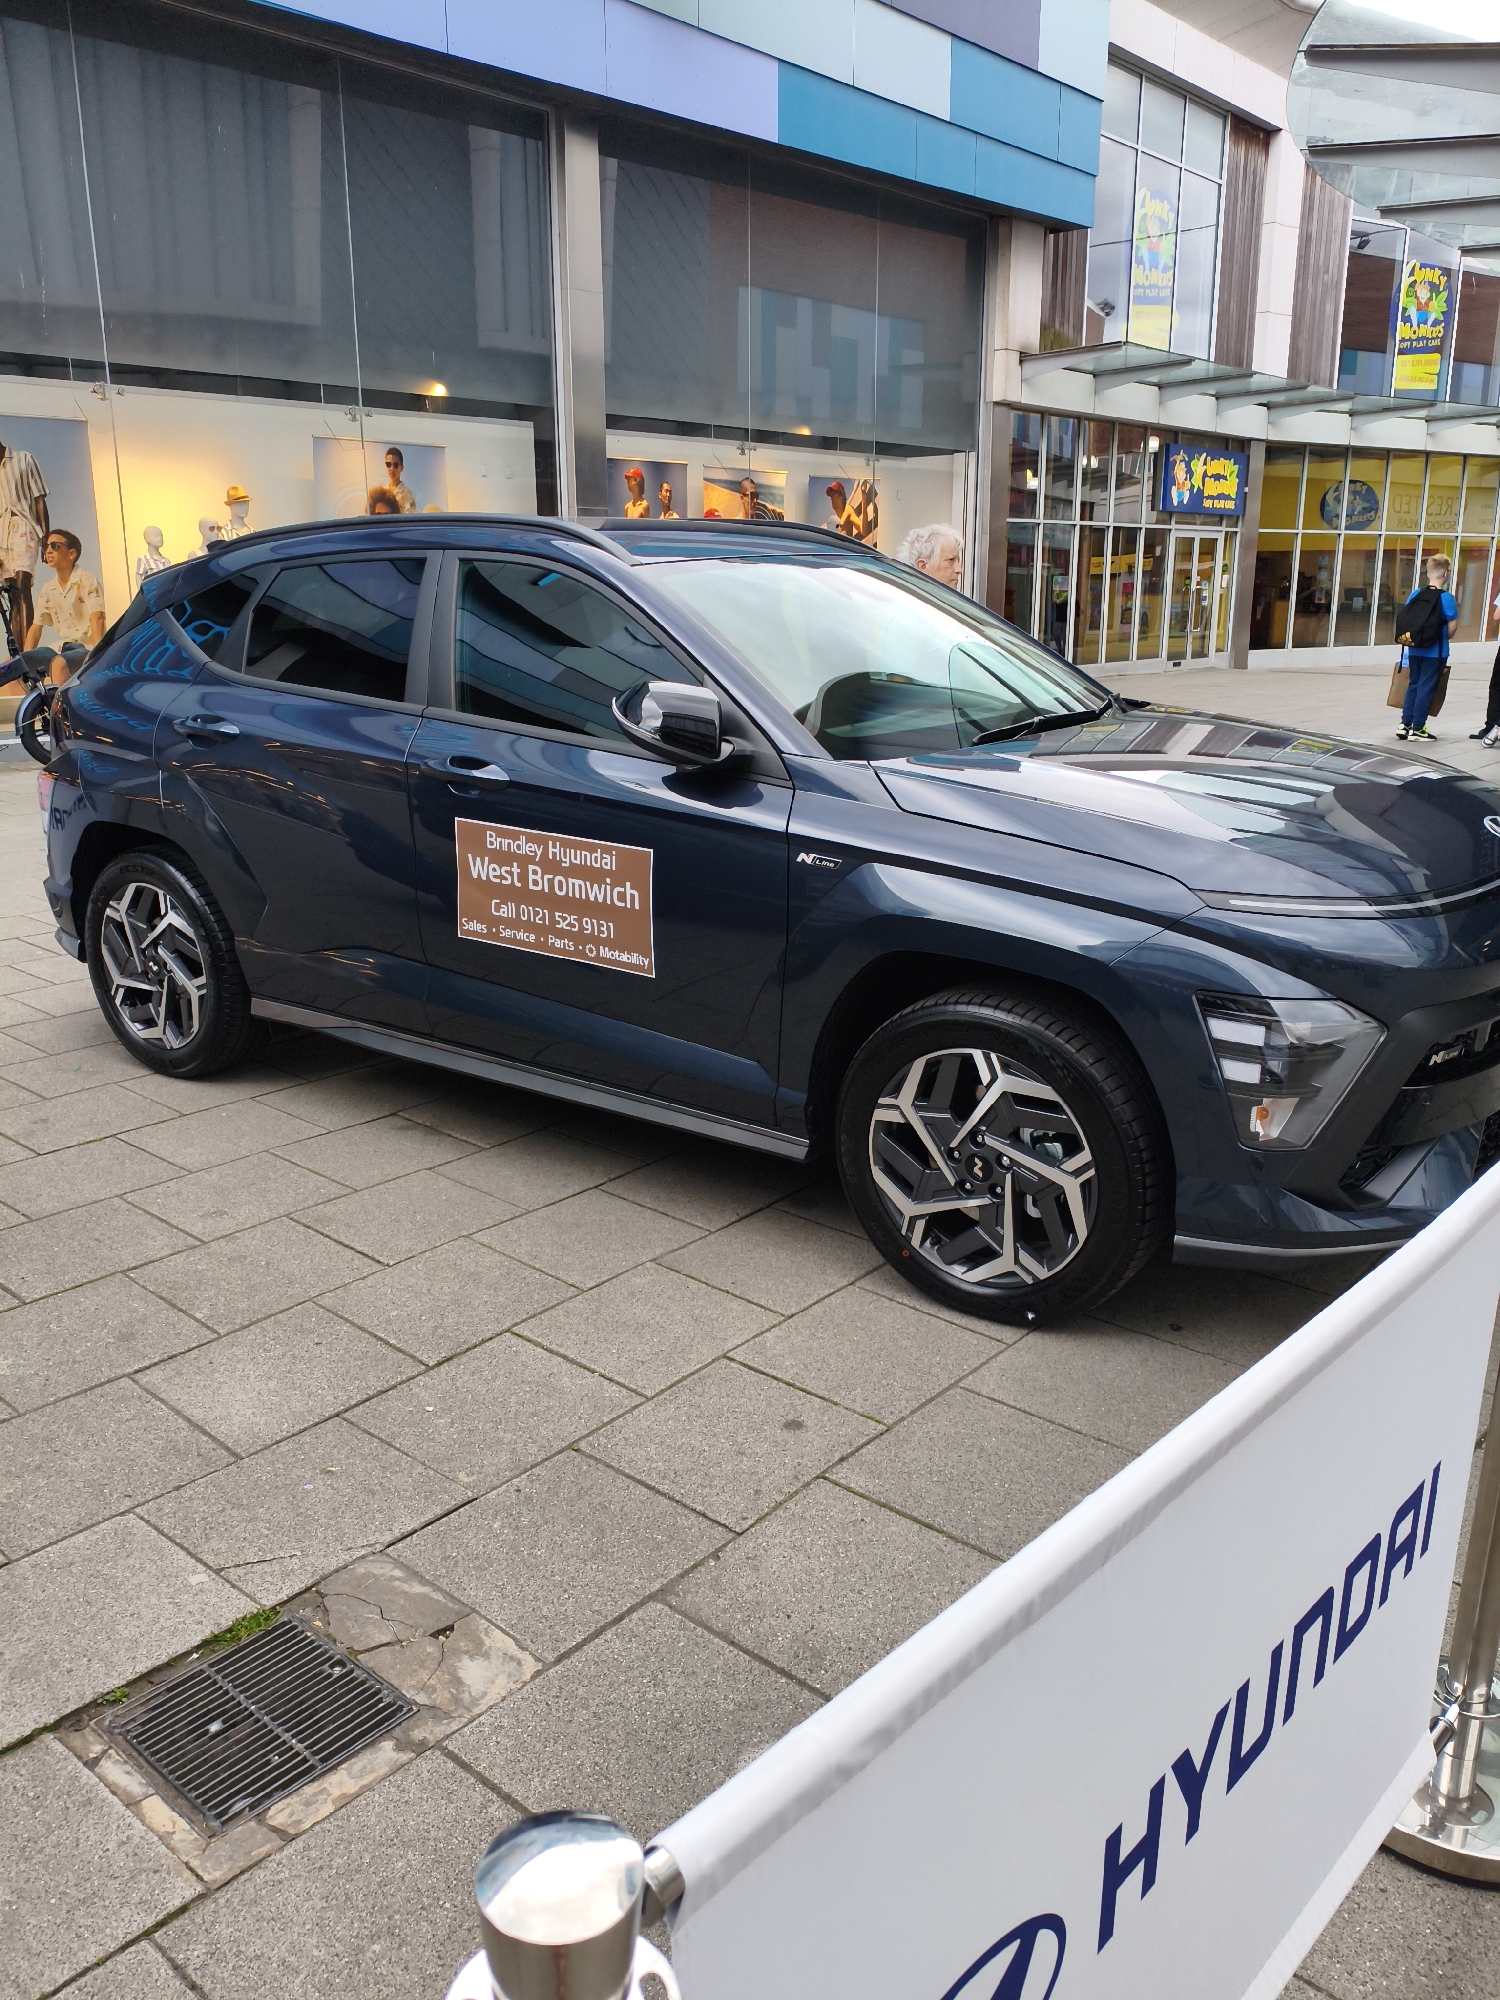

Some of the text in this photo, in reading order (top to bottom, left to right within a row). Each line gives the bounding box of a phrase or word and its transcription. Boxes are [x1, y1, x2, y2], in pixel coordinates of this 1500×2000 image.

[1133, 288, 1144, 297] OFT
[486, 830, 616, 871] Brindley Hyundai
[467, 853, 640, 910] West Bromwich
[491, 899, 614, 939] Call 0121 525 9131
[461, 917, 650, 970] Sales Service Parts Motability
[1097, 1460, 1441, 1955] HYUNDAI
